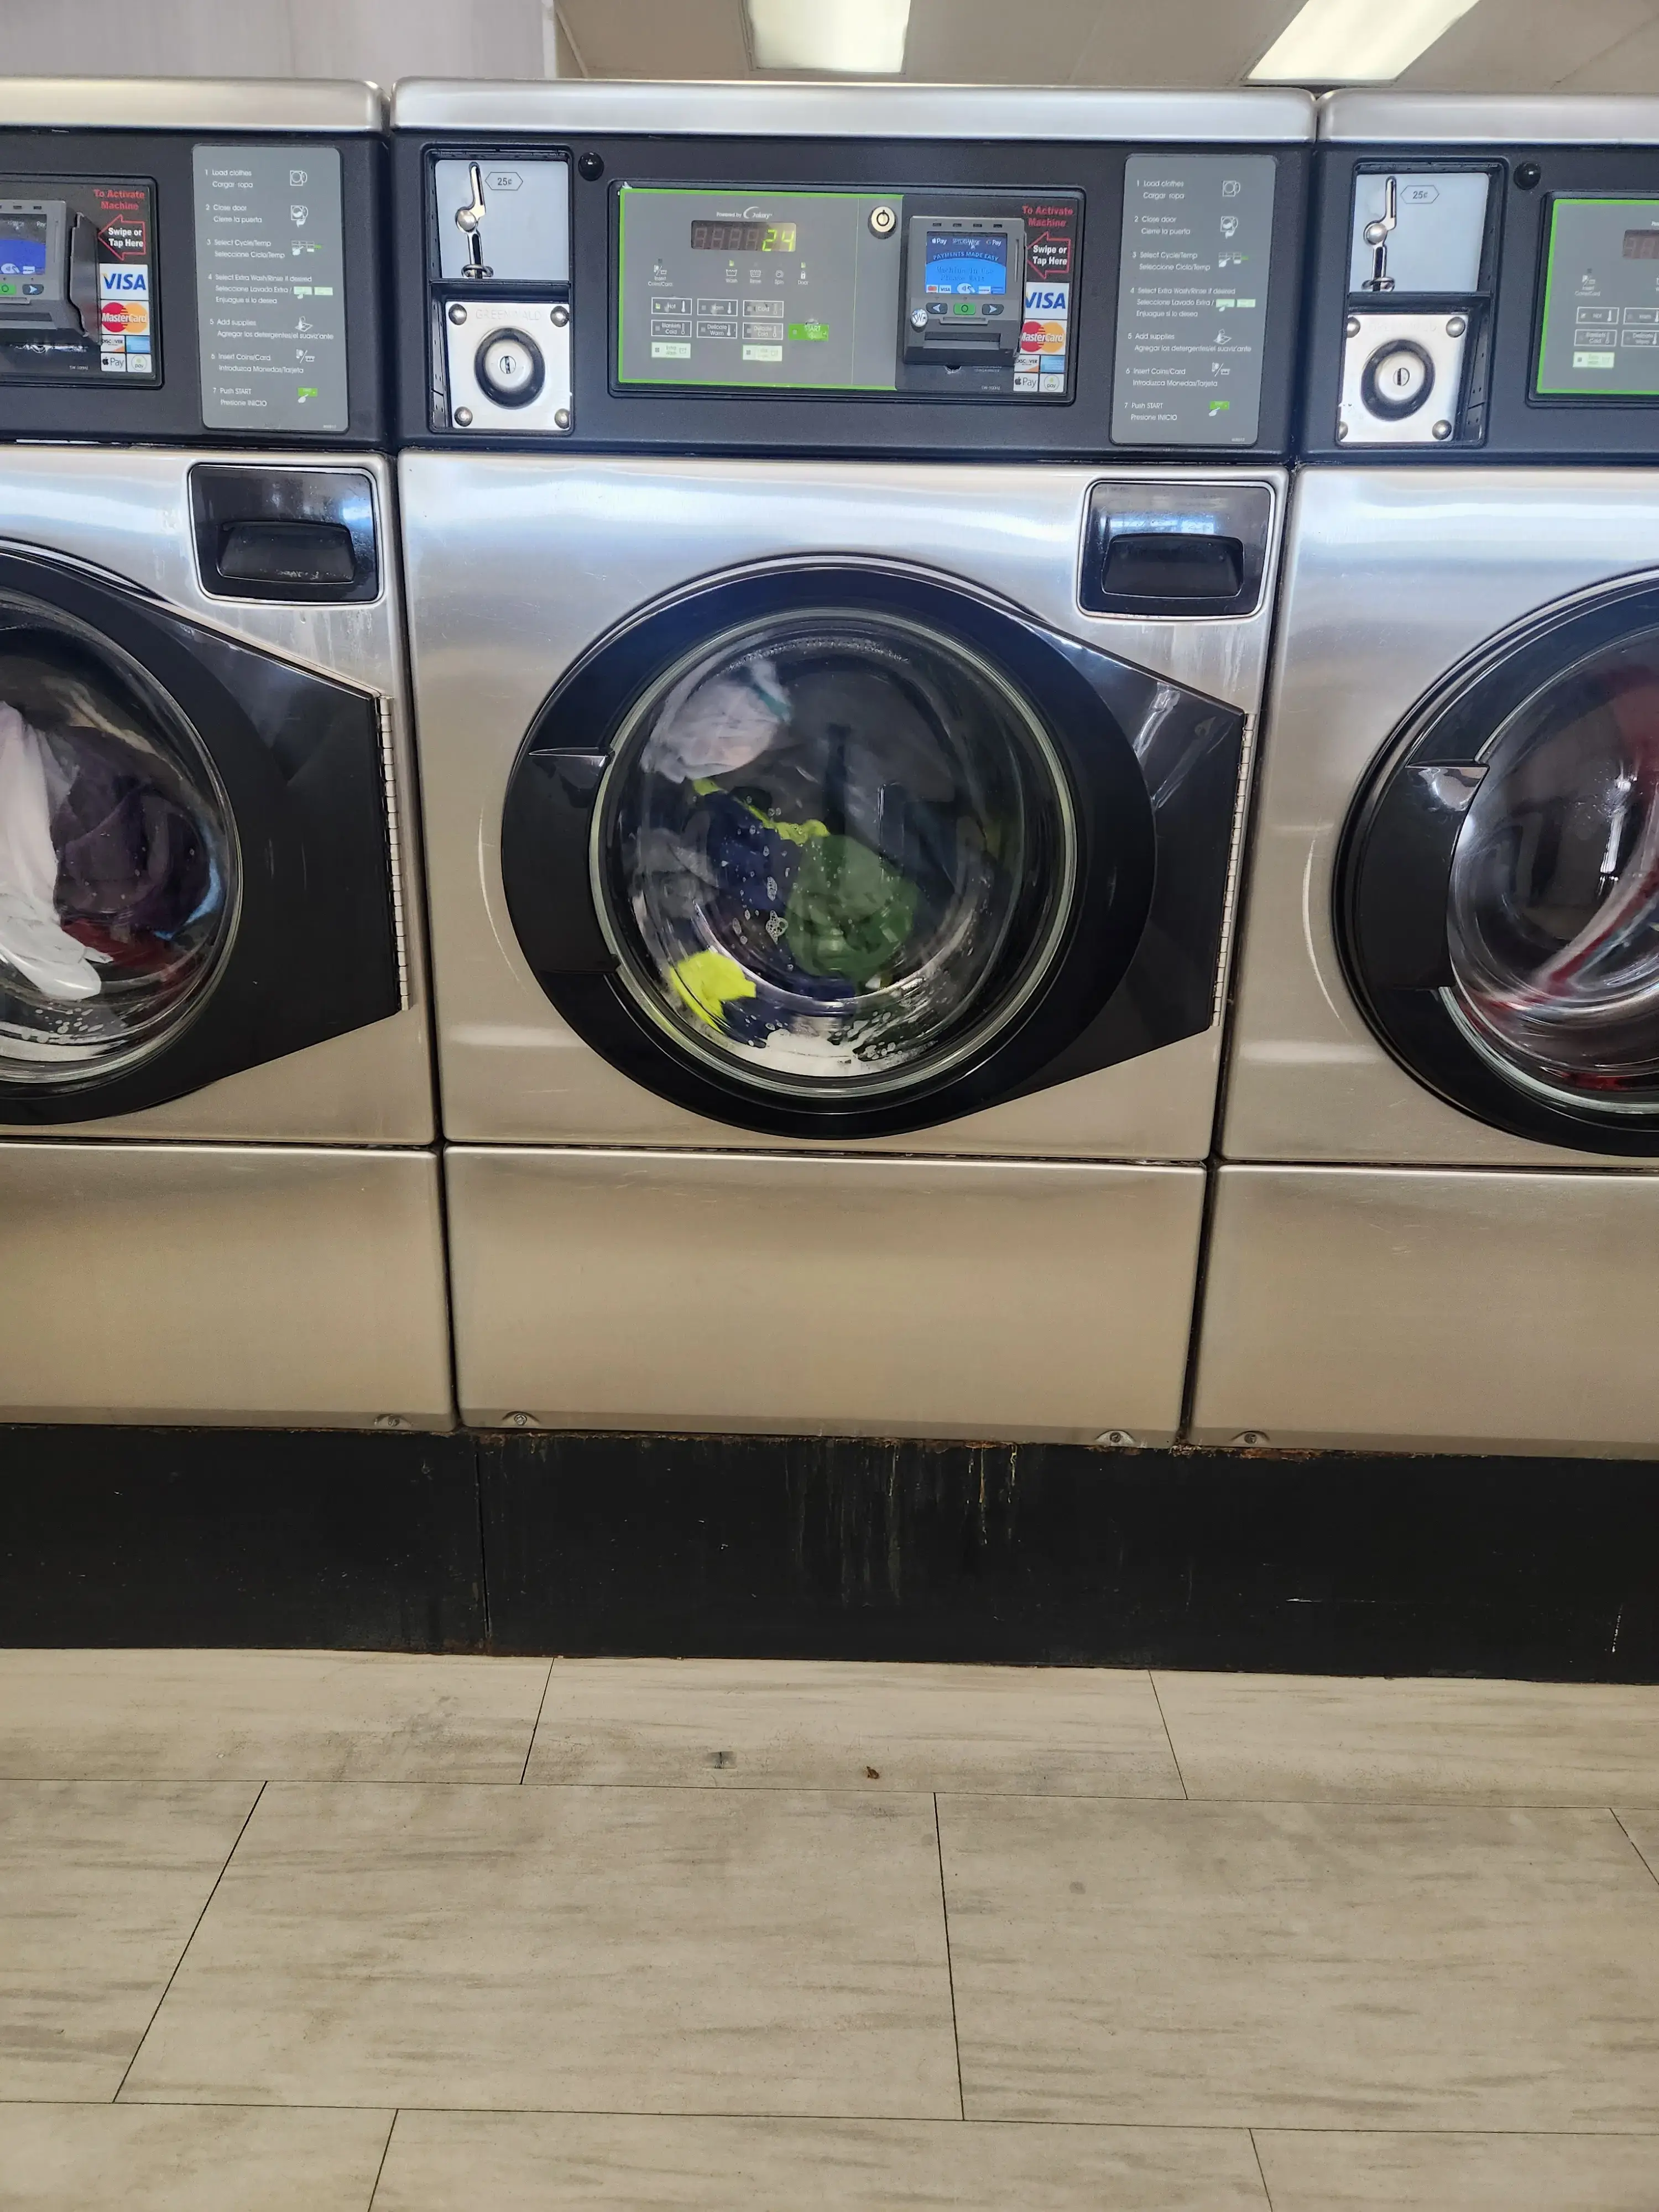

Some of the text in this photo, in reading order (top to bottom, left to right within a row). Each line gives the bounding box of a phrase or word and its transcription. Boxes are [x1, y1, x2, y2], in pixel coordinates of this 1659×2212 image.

[498, 177, 512, 185] 25¢
[93, 189, 145, 199] To Activate
[1143, 192, 1166, 200] Cargar
[101, 201, 139, 210] Machine
[1022, 206, 1073, 216] To Activate
[1028, 218, 1066, 227] Machine
[108, 227, 132, 237] Swipe
[108, 238, 123, 248] Tap
[762, 229, 796, 252] 24
[1033, 245, 1056, 255] Swipe
[933, 251, 964, 260] PAYMENTS
[984, 253, 999, 262] EASY
[1032, 256, 1047, 266] Tap
[102, 273, 146, 290] VISA
[1025, 292, 1066, 309] VISA
[102, 312, 147, 323] MasterCard
[111, 357, 124, 368] Pay
[253, 366, 304, 374] Monedas/Tarjeta
[1022, 377, 1036, 388] Pay
[1167, 379, 1218, 388] Monedas/Tarjeta
